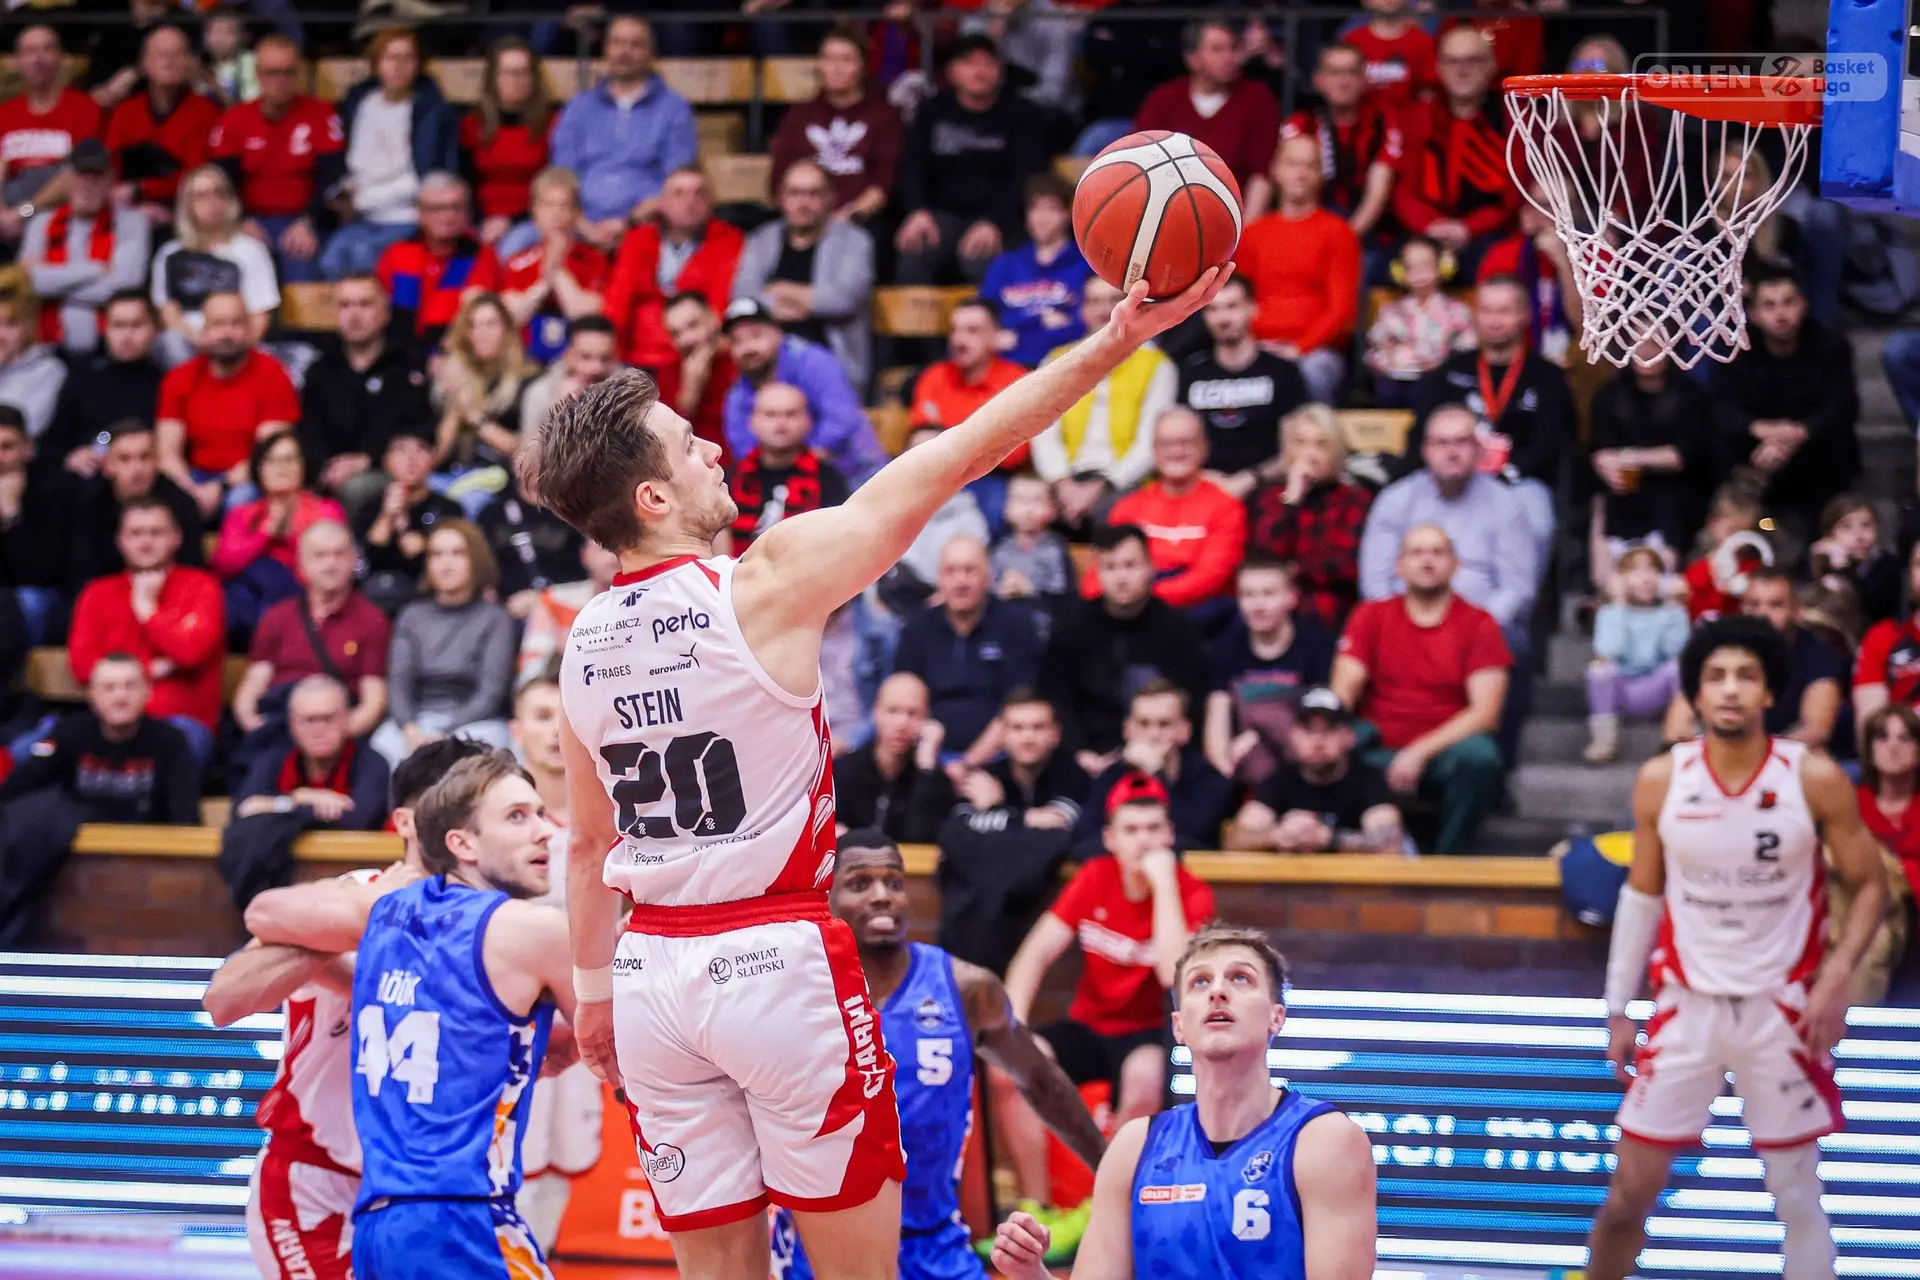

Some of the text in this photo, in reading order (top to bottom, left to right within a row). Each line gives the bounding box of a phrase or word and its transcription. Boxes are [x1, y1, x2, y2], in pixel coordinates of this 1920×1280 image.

[572, 625, 602, 639] GRAND
[652, 607, 710, 643] perla
[597, 664, 632, 681] FRAGES
[649, 659, 692, 676] eurowind
[613, 687, 684, 730] STEIN
[599, 731, 748, 840] 20
[1755, 831, 1780, 863] 2
[734, 947, 779, 966] POWIAT
[736, 959, 786, 979] SŁUPSKI
[355, 1004, 441, 1105] 44
[916, 1037, 953, 1087] 5
[1231, 1188, 1271, 1242] 6
